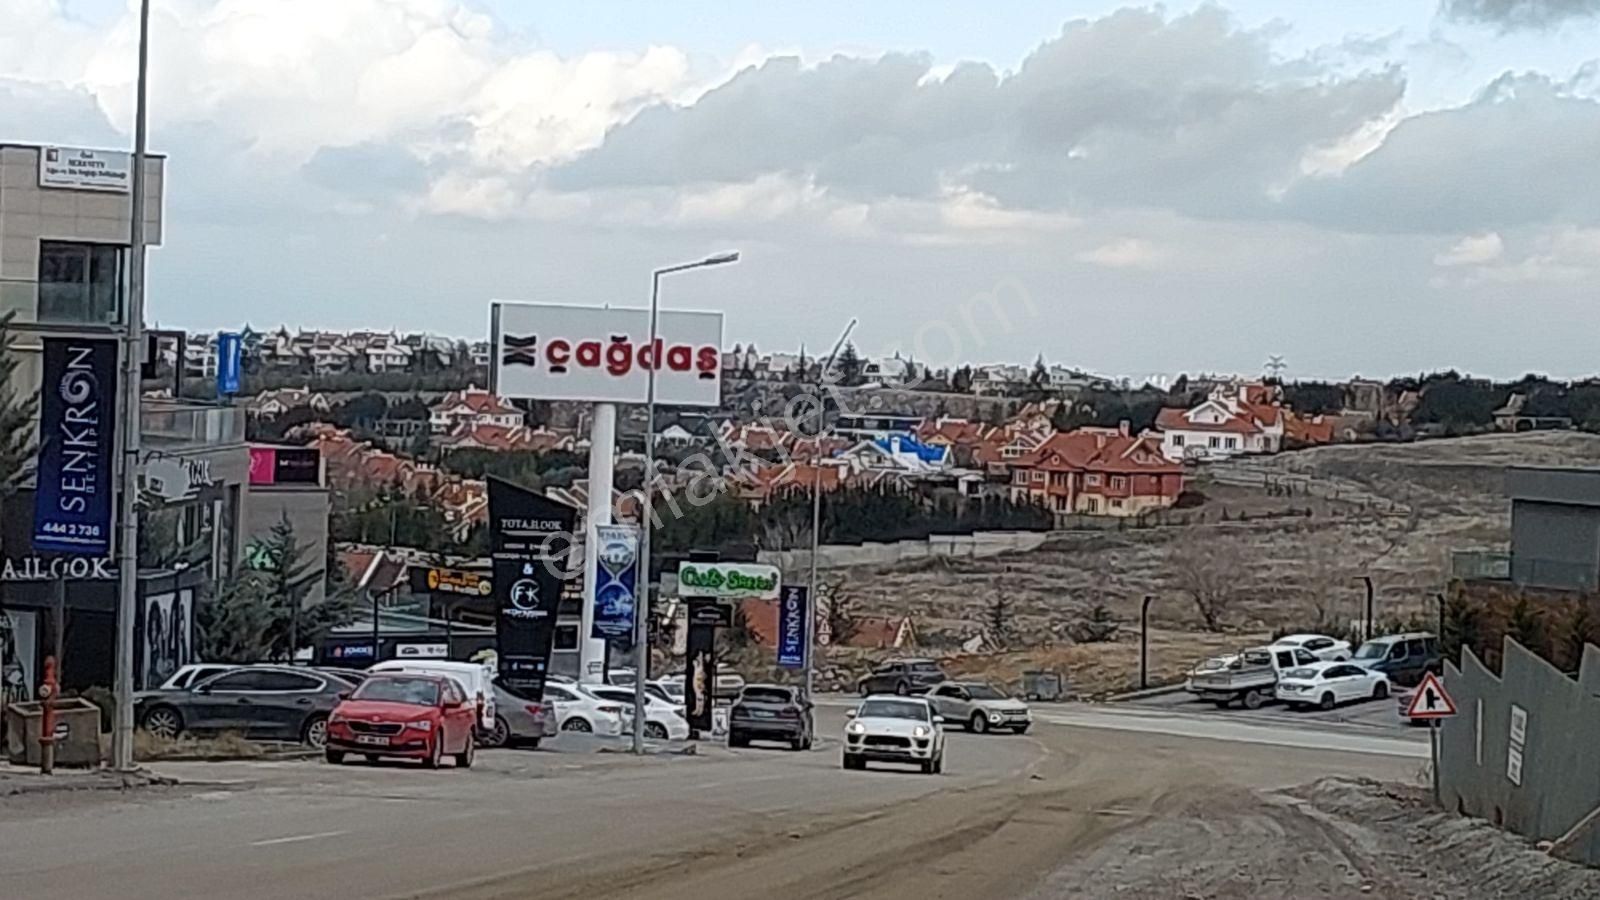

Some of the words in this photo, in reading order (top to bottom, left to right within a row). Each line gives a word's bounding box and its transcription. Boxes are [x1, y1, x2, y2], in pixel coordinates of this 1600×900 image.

[546, 335, 718, 380] çağdaş
[60, 346, 98, 512] SENKRON
[42, 522, 66, 533] 444
[68, 524, 76, 534] 2
[785, 588, 801, 653] SENKRON
